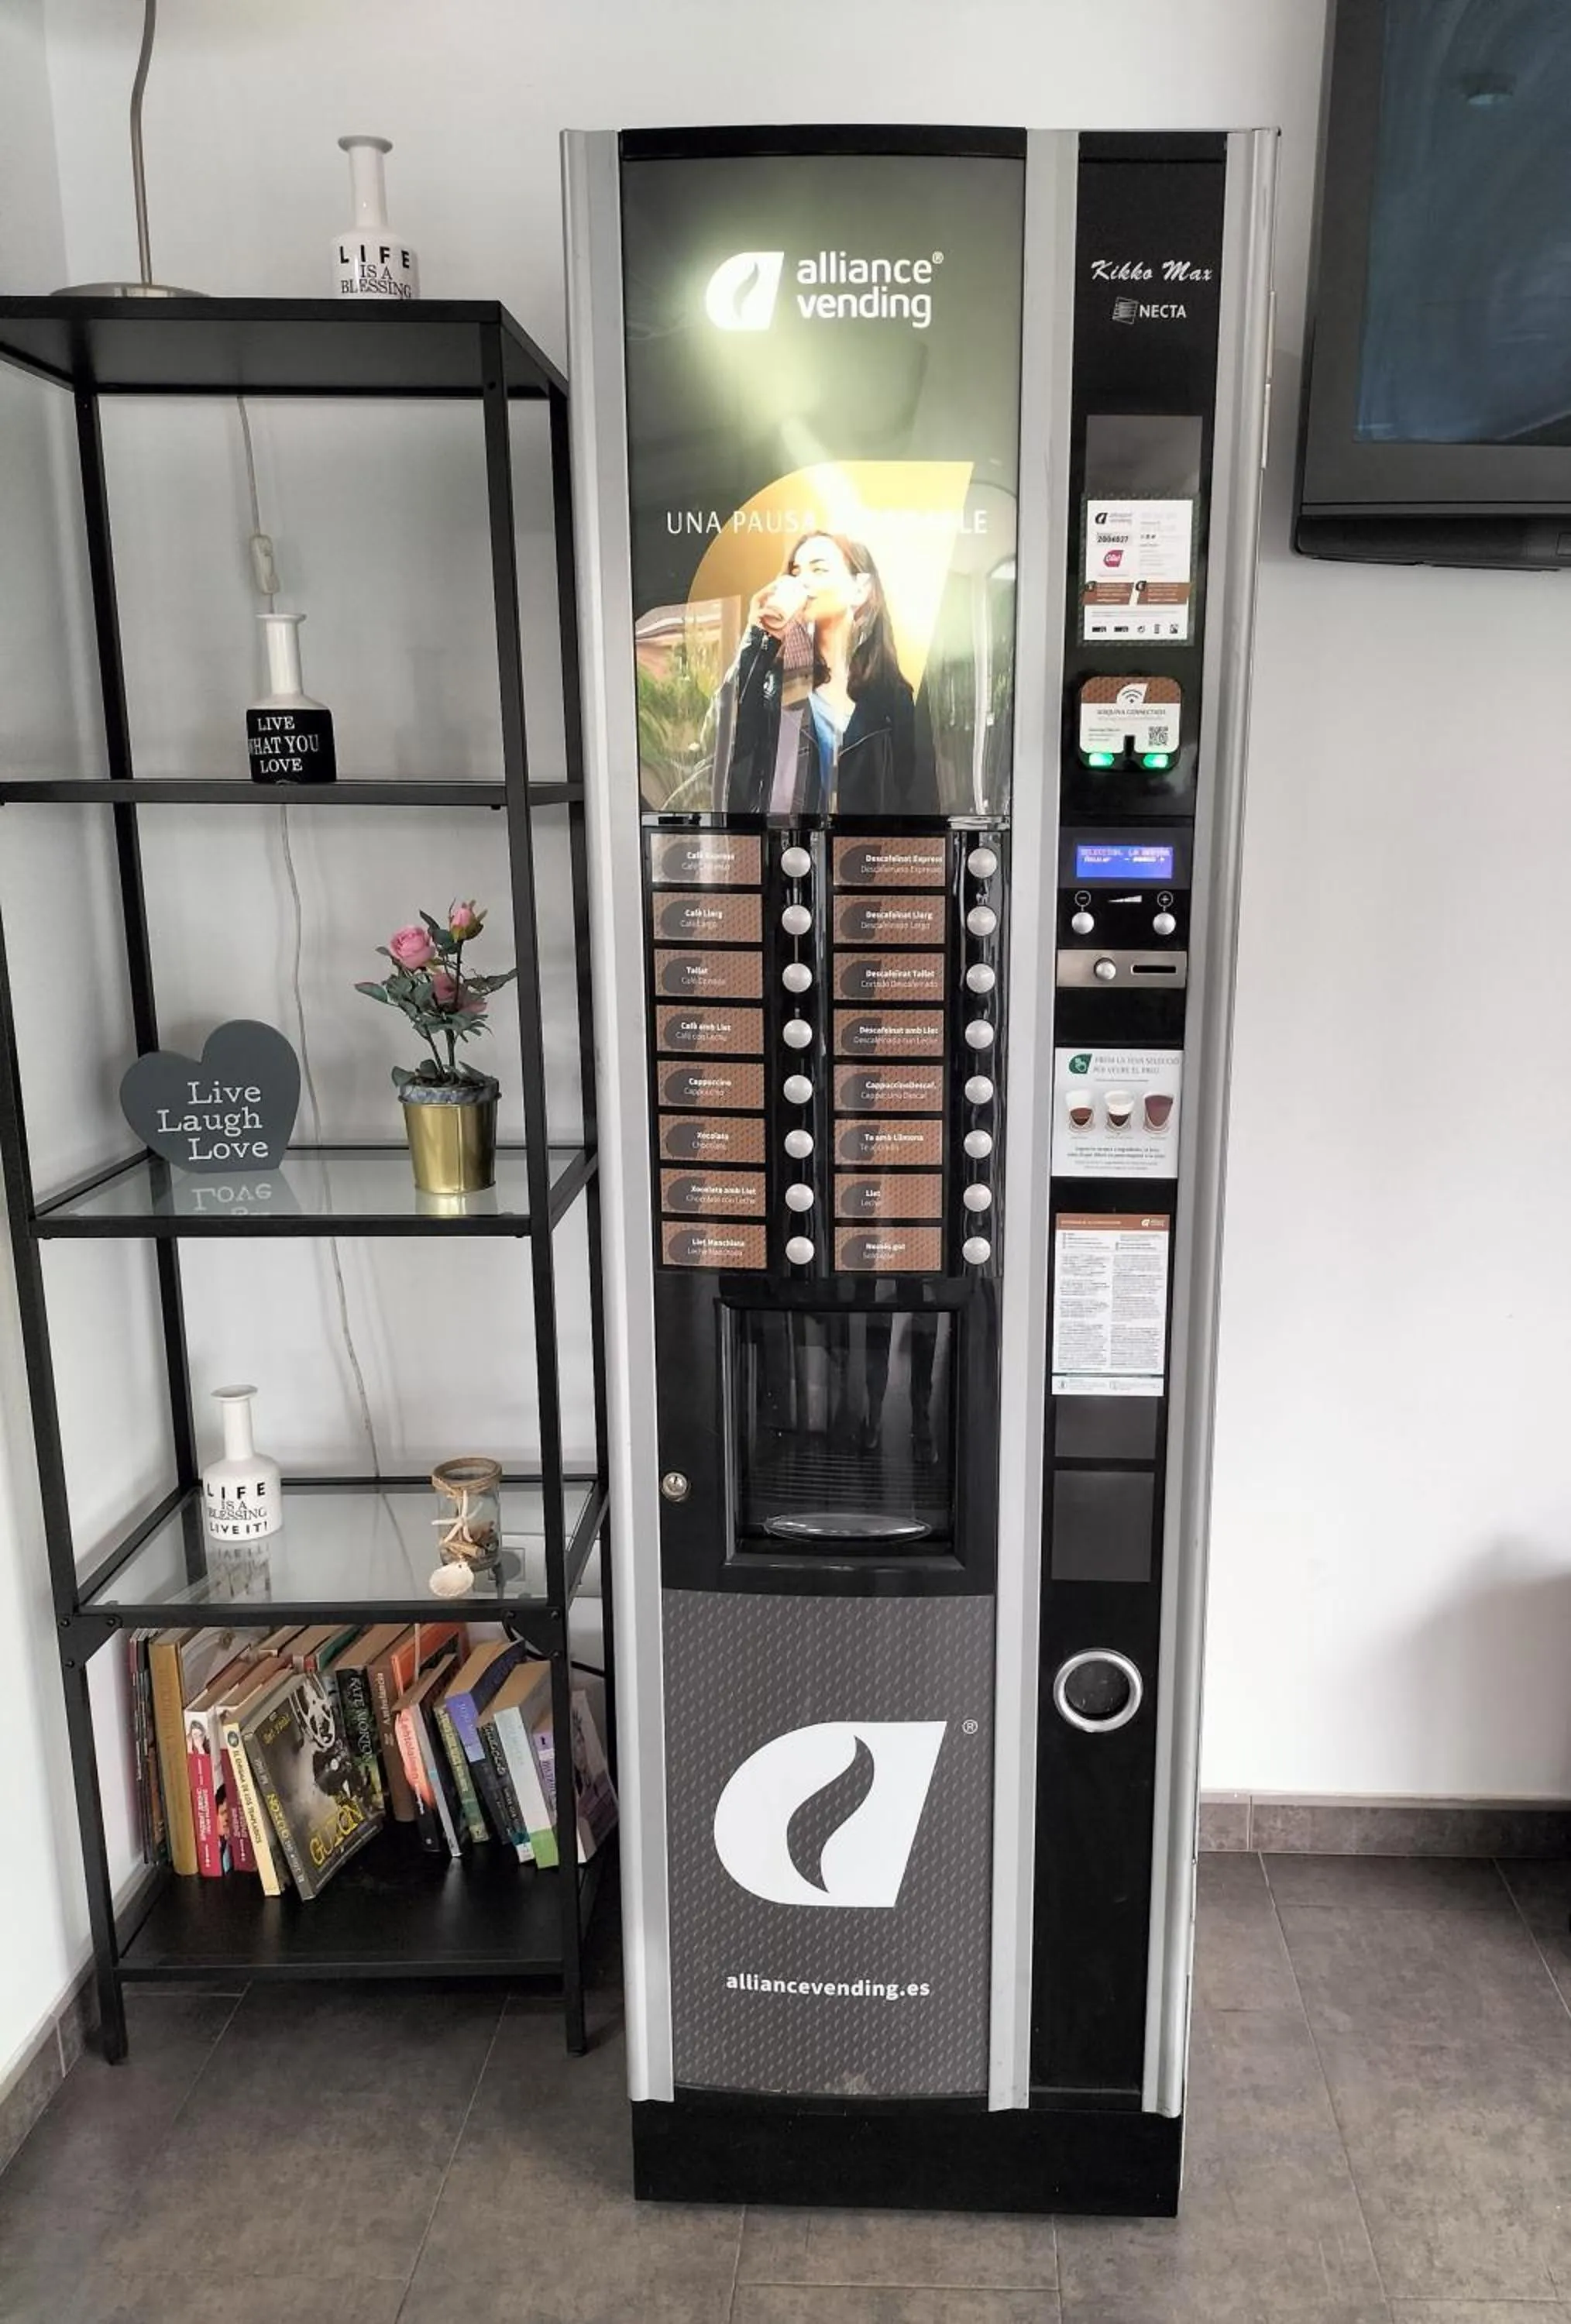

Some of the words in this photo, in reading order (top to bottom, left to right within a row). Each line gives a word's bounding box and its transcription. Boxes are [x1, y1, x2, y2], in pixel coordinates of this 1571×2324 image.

[339, 245, 410, 269] LIFE
[359, 265, 377, 278] IS
[382, 266, 393, 280] A
[1091, 260, 1153, 281] Kikko
[1162, 260, 1212, 281] Max
[341, 280, 411, 300] BLESSING
[796, 287, 932, 328] vending
[1140, 304, 1187, 318] NECTA
[666, 511, 721, 534] UNA
[733, 509, 817, 534] PAUSA
[257, 716, 295, 731] LIVE
[284, 734, 318, 753] YOU
[260, 758, 303, 774] LOVE
[187, 1081, 261, 1105] Live
[156, 1106, 263, 1137] Laugh
[187, 1137, 269, 1160] Love
[207, 1482, 266, 1500] LIFE
[208, 1507, 267, 1521] BLESSING
[221, 1501, 234, 1511] IS
[239, 1501, 247, 1511] A
[210, 1522, 239, 1535] LIVE
[246, 1521, 267, 1534] IT!
[726, 1973, 930, 2000] alliancevending.es
